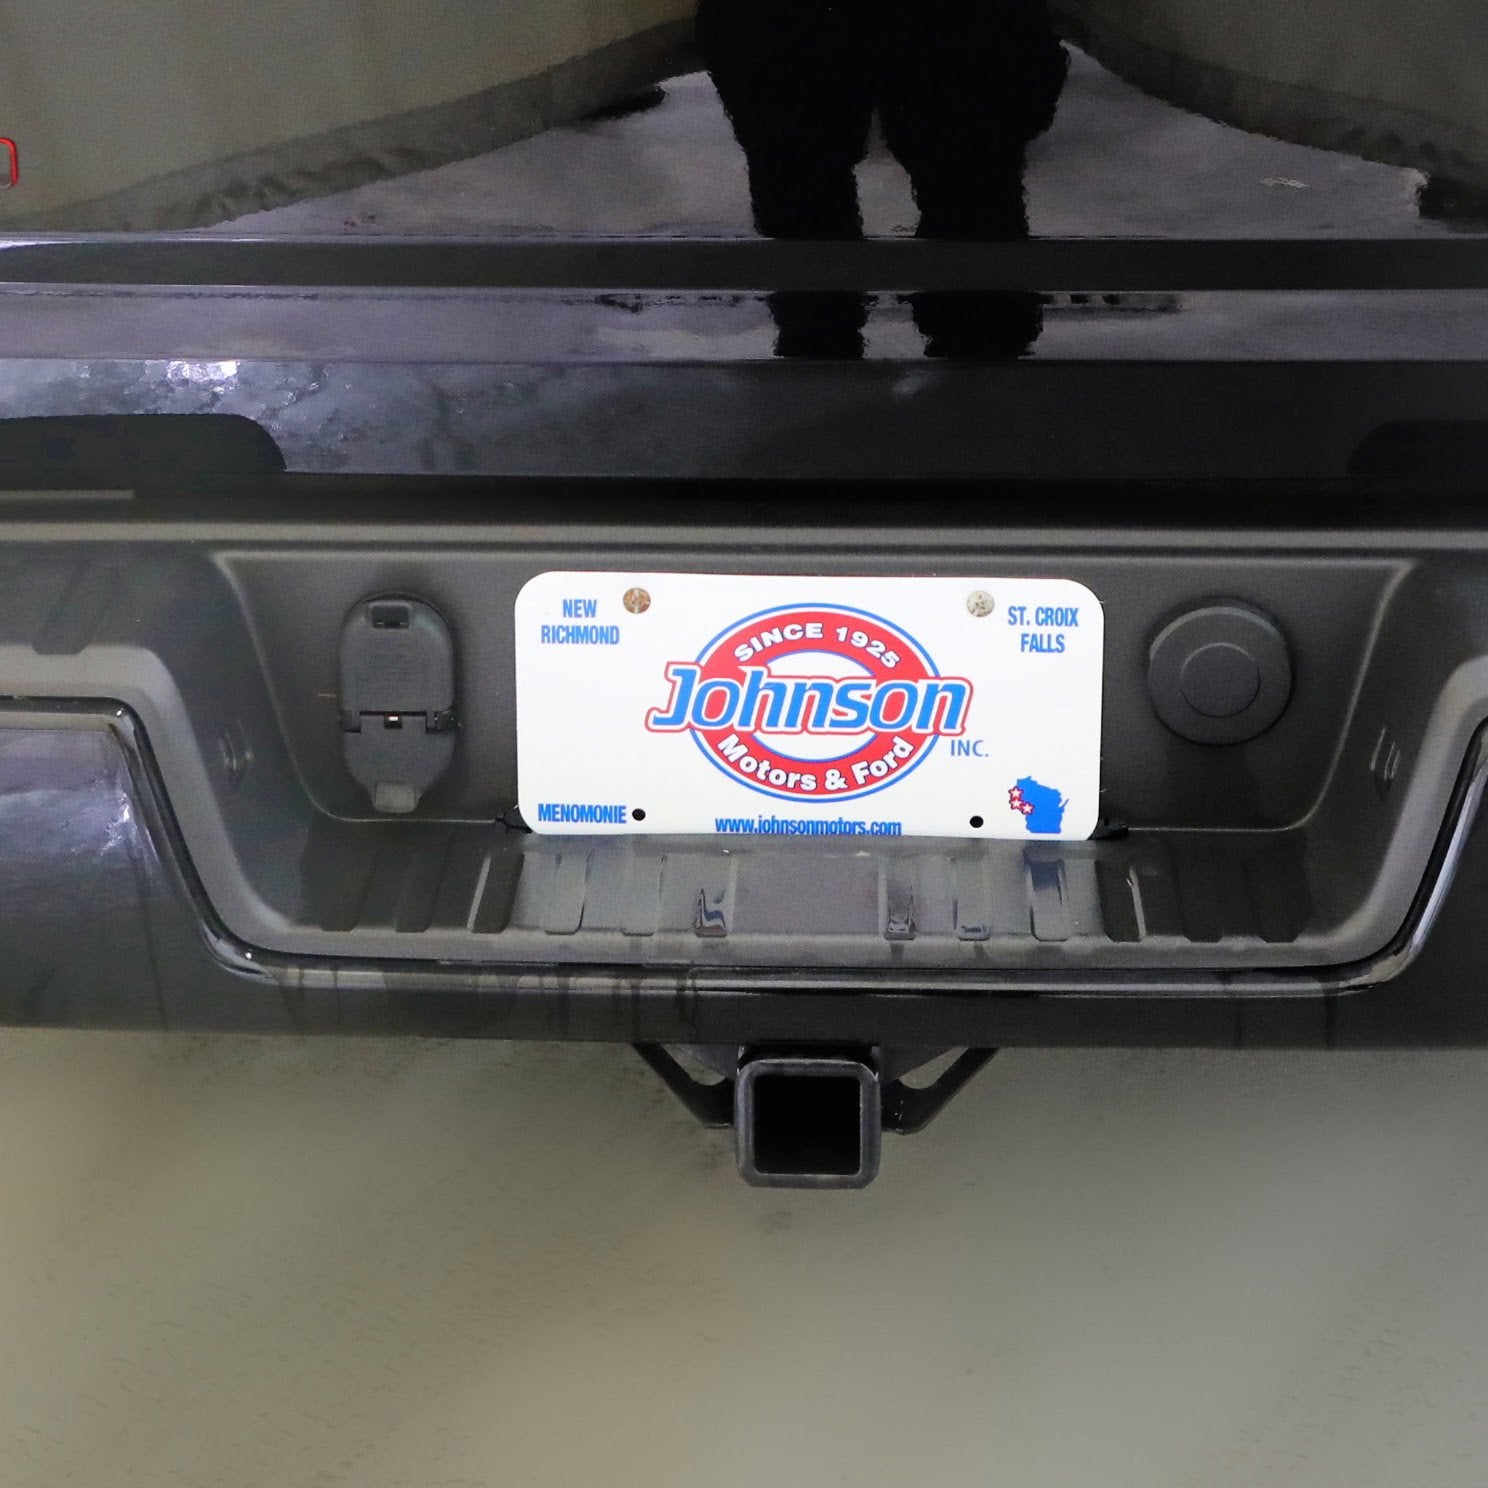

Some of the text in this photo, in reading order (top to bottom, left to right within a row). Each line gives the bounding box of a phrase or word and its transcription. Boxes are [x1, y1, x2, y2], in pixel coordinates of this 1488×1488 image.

[562, 599, 597, 619] NEW
[1007, 606, 1079, 627] ST. CROIX
[540, 625, 620, 646] RICHMOND
[734, 622, 902, 669] SINCE 1925
[1020, 633, 1066, 654] FALLS
[649, 665, 970, 732] Johnson
[950, 738, 990, 758] INC.
[717, 733, 914, 791] Motors & Ford
[537, 803, 627, 824] MENOMONIE
[714, 815, 902, 836] www.johnsonmotors.com
